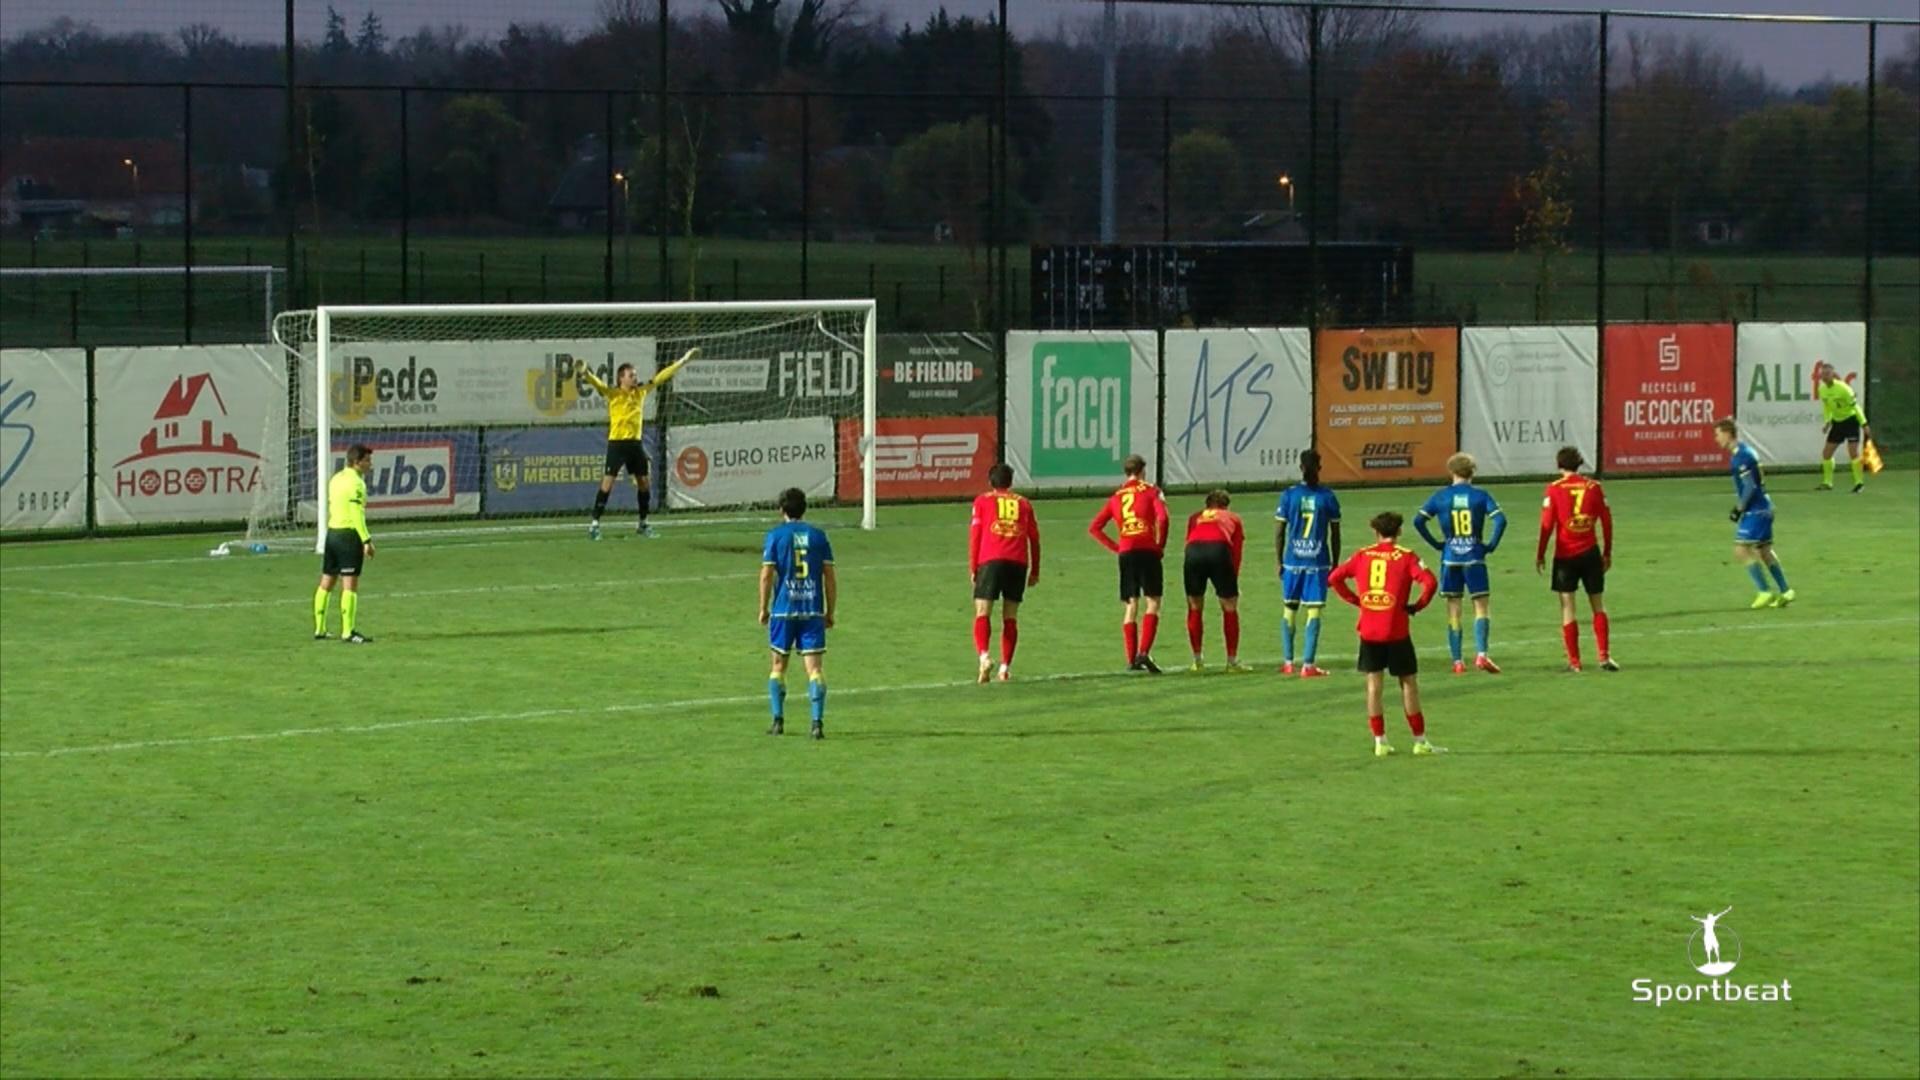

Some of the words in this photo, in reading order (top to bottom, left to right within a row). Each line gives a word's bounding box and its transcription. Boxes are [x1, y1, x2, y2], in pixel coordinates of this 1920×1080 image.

[894, 361, 913, 383] BE
[916, 360, 974, 383] FIELDED
[1641, 381, 1697, 394] RECYCLING
[1040, 355, 1121, 461] facq
[1177, 338, 1274, 466] ATS
[1624, 400, 1646, 426] DE
[1648, 398, 1714, 425] COCKER
[1494, 419, 1566, 443] WEAM
[713, 447, 764, 468] EURO
[768, 443, 826, 464] REPAR
[117, 466, 266, 497] HOBOTRA
[335, 455, 447, 496] ubo
[997, 497, 1019, 521] 18
[1121, 493, 1136, 519] 2
[1570, 489, 1585, 515] 7
[1302, 513, 1315, 539] 7
[1451, 510, 1472, 536] 18
[794, 549, 809, 579] 5
[1370, 559, 1387, 588] 8
